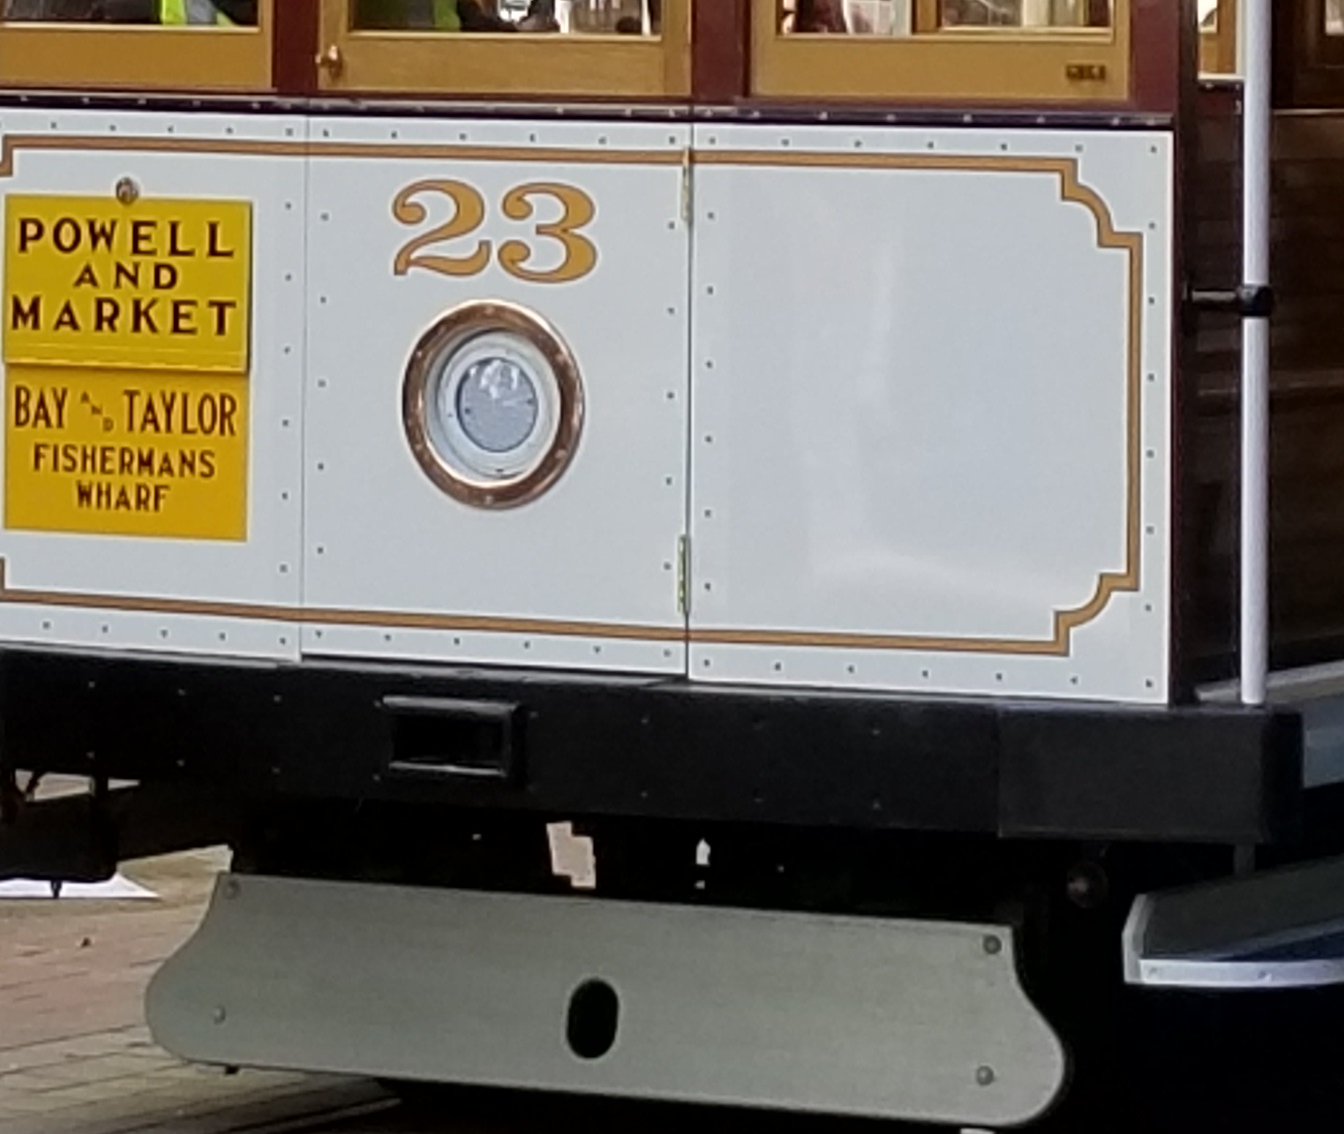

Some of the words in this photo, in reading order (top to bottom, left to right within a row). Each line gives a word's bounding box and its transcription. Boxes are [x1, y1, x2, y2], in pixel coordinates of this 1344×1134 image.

[17, 216, 235, 258] POWELL
[391, 178, 598, 284] 23
[72, 261, 179, 291] AND
[11, 293, 237, 337] MARKET
[14, 384, 69, 430] BAY
[79, 390, 115, 433] AND
[123, 388, 239, 437] TAYLOR
[32, 441, 216, 479] FISHERMANS
[76, 479, 171, 513] WHARF
